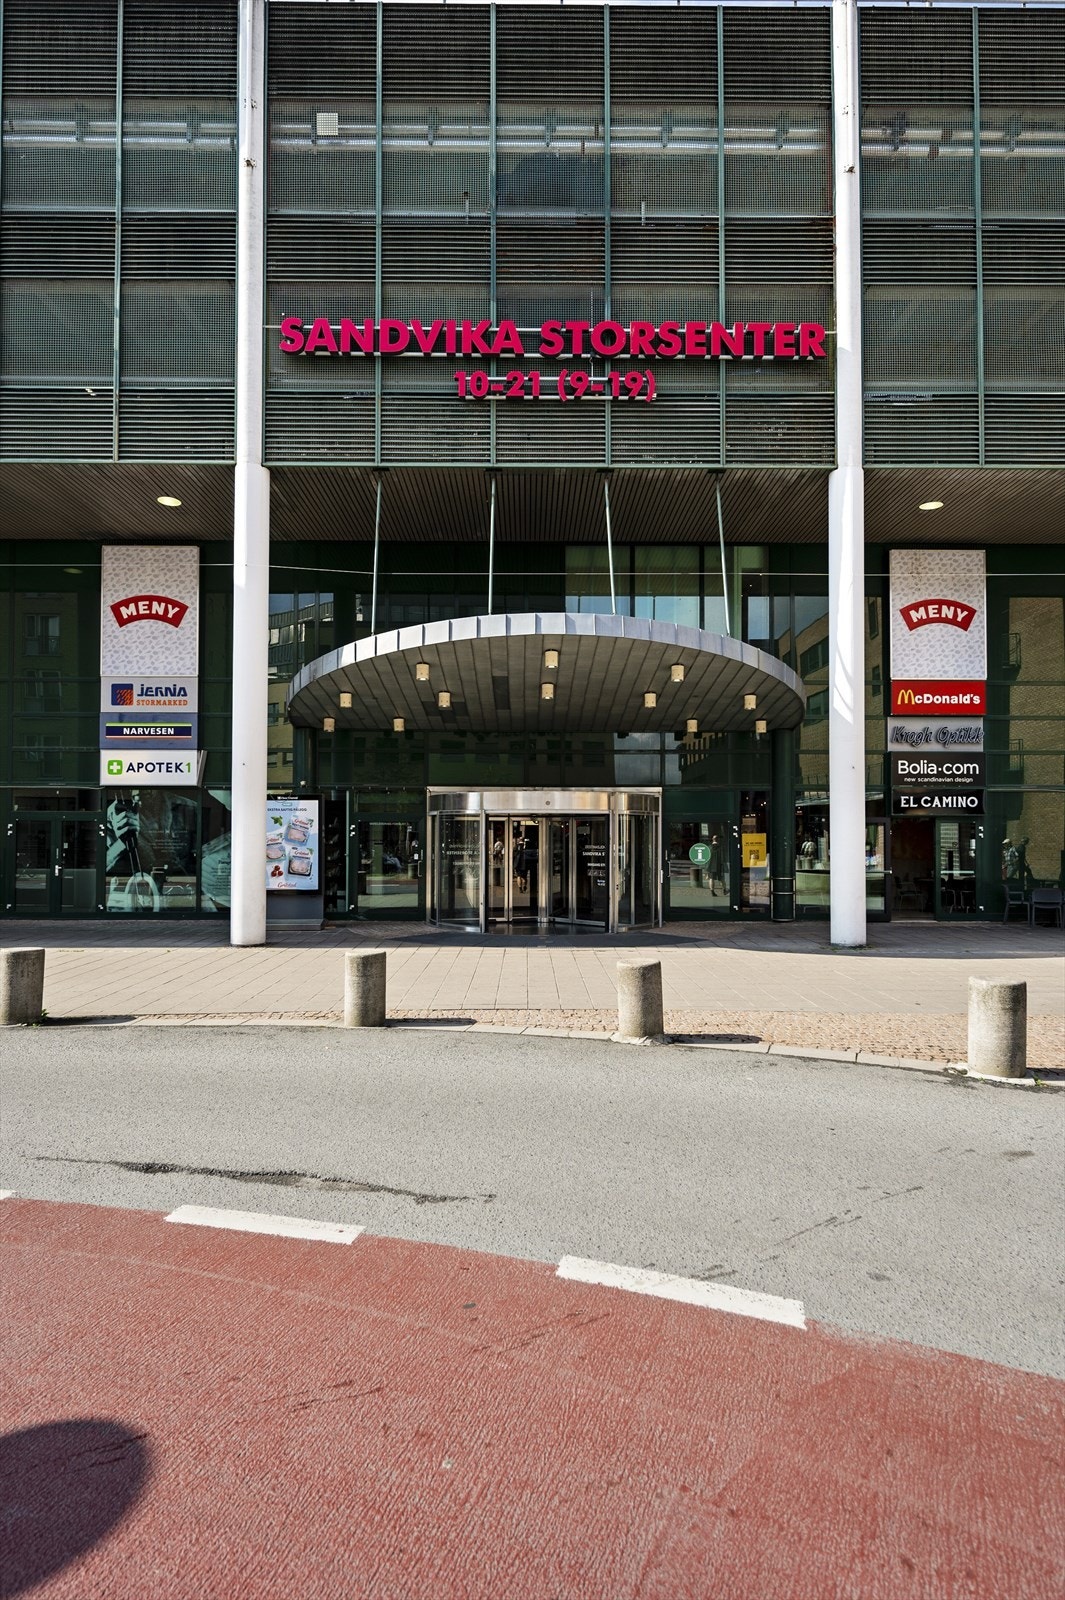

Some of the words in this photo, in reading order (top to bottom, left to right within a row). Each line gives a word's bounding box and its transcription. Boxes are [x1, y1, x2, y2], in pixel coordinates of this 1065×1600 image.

[279, 317, 524, 355] SANDVIKA
[539, 320, 827, 357] STORSENTER
[454, 370, 541, 398] 10-21
[557, 369, 656, 401] (9-19)
[120, 601, 180, 619] MENY
[909, 605, 969, 623] MENY
[897, 689, 981, 705] McDonald's
[123, 727, 175, 735] NARVESEN
[890, 726, 933, 748] Krogh
[900, 796, 918, 807] EL
[920, 796, 979, 808] CAMINO
